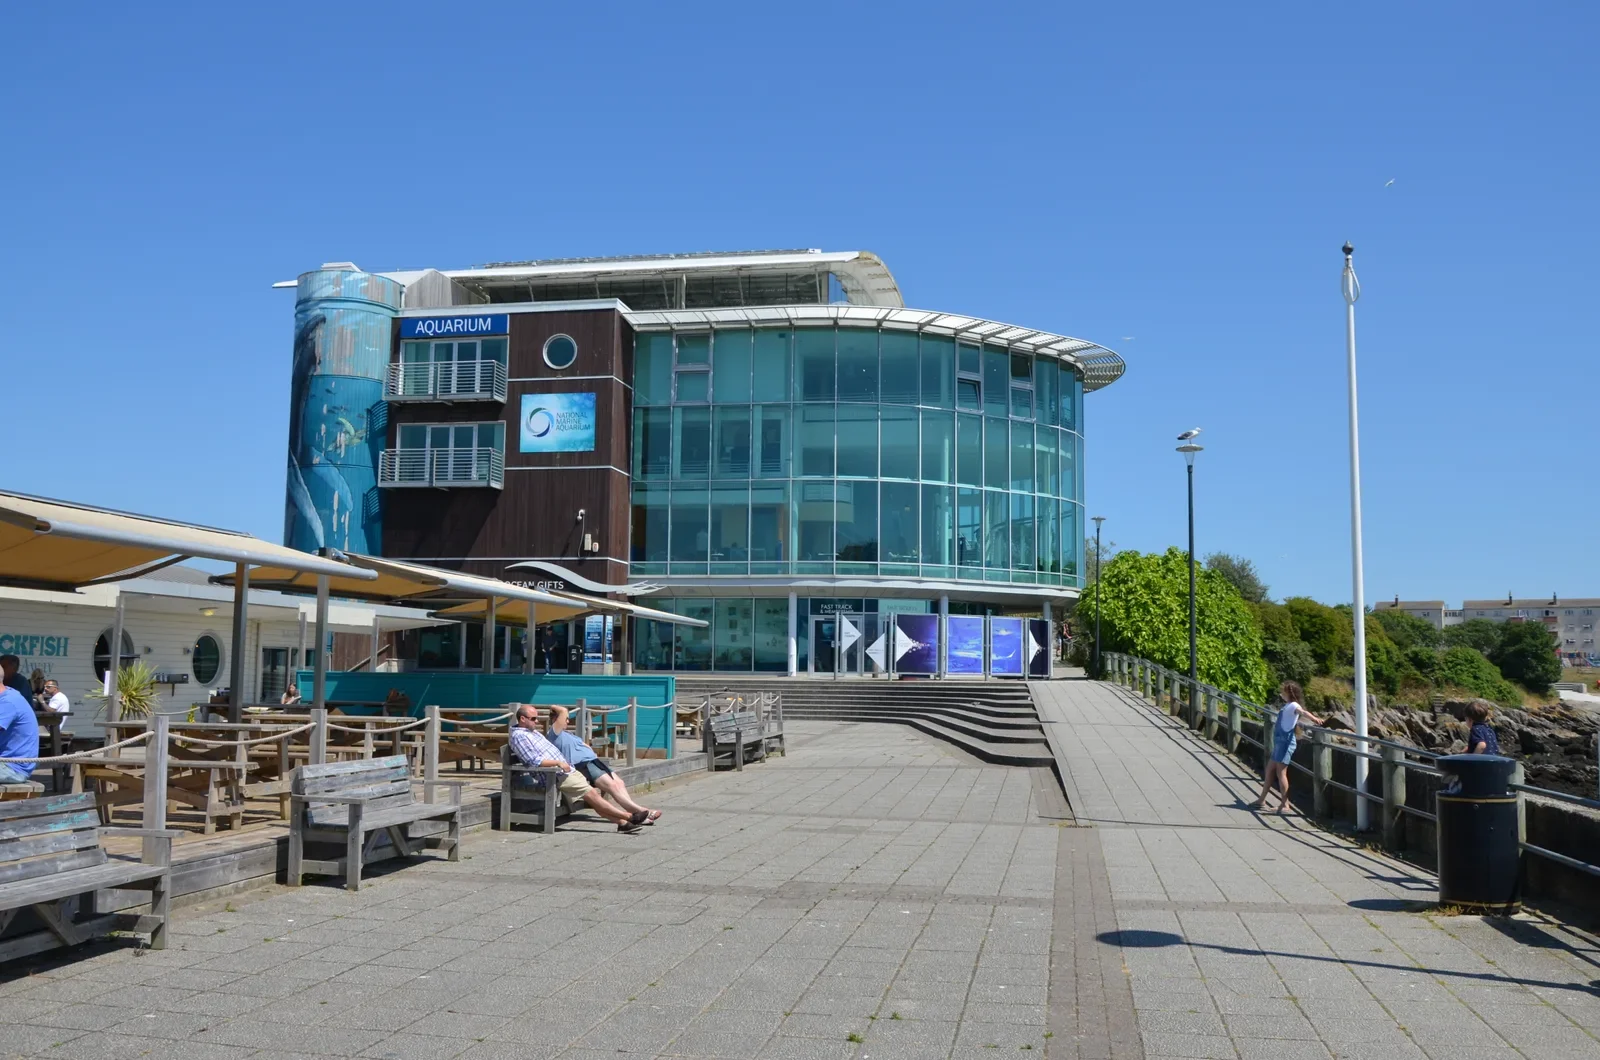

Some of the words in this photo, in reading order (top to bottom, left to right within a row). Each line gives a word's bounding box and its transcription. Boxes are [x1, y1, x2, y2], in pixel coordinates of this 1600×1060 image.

[415, 317, 491, 336] AQUARIUM
[556, 411, 588, 419] NATIONAL
[556, 424, 591, 432] AQUARIUM
[537, 581, 564, 590] GIFTS
